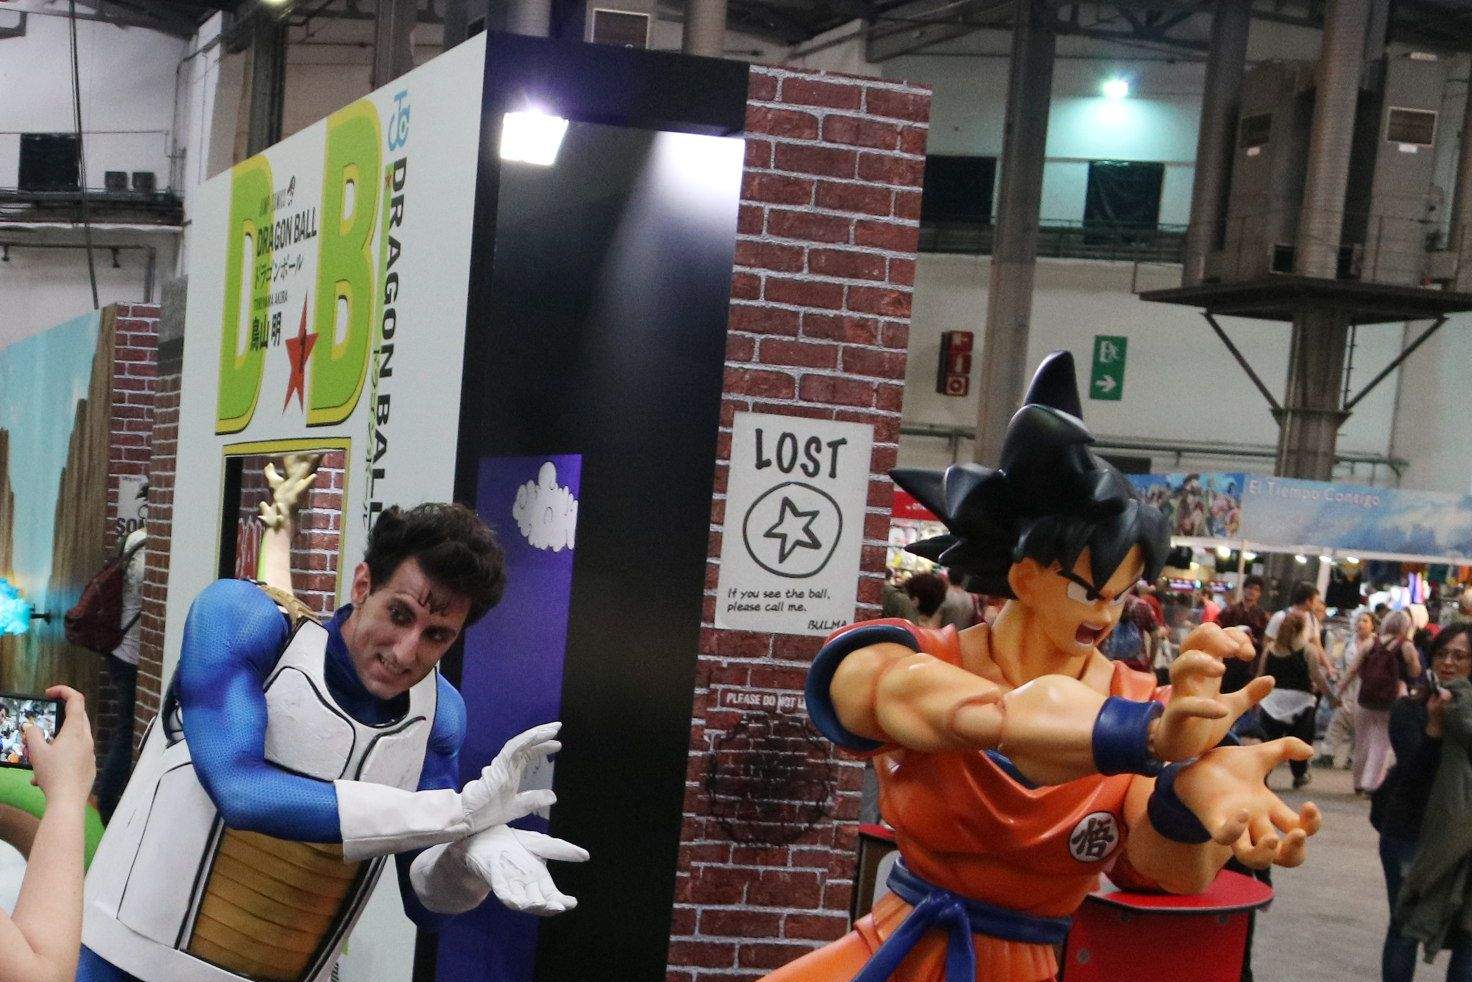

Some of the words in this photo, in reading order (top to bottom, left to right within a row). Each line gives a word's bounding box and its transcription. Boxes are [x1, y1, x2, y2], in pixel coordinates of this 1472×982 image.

[257, 216, 292, 257] DRAGON
[293, 206, 317, 243] BALL
[254, 252, 304, 291] ドラゴンボール
[379, 156, 408, 379] DRAGON
[754, 428, 848, 479] LOST
[727, 588, 738, 598] If
[740, 590, 760, 600] you
[763, 590, 782, 599] see
[785, 589, 805, 599] the
[727, 601, 761, 613] please
[764, 602, 785, 612] call
[787, 604, 807, 612] me.
[807, 619, 847, 630] BULMA
[726, 692, 761, 705] PLEASE
[762, 696, 776, 706] DO
[778, 697, 797, 708] NOT
